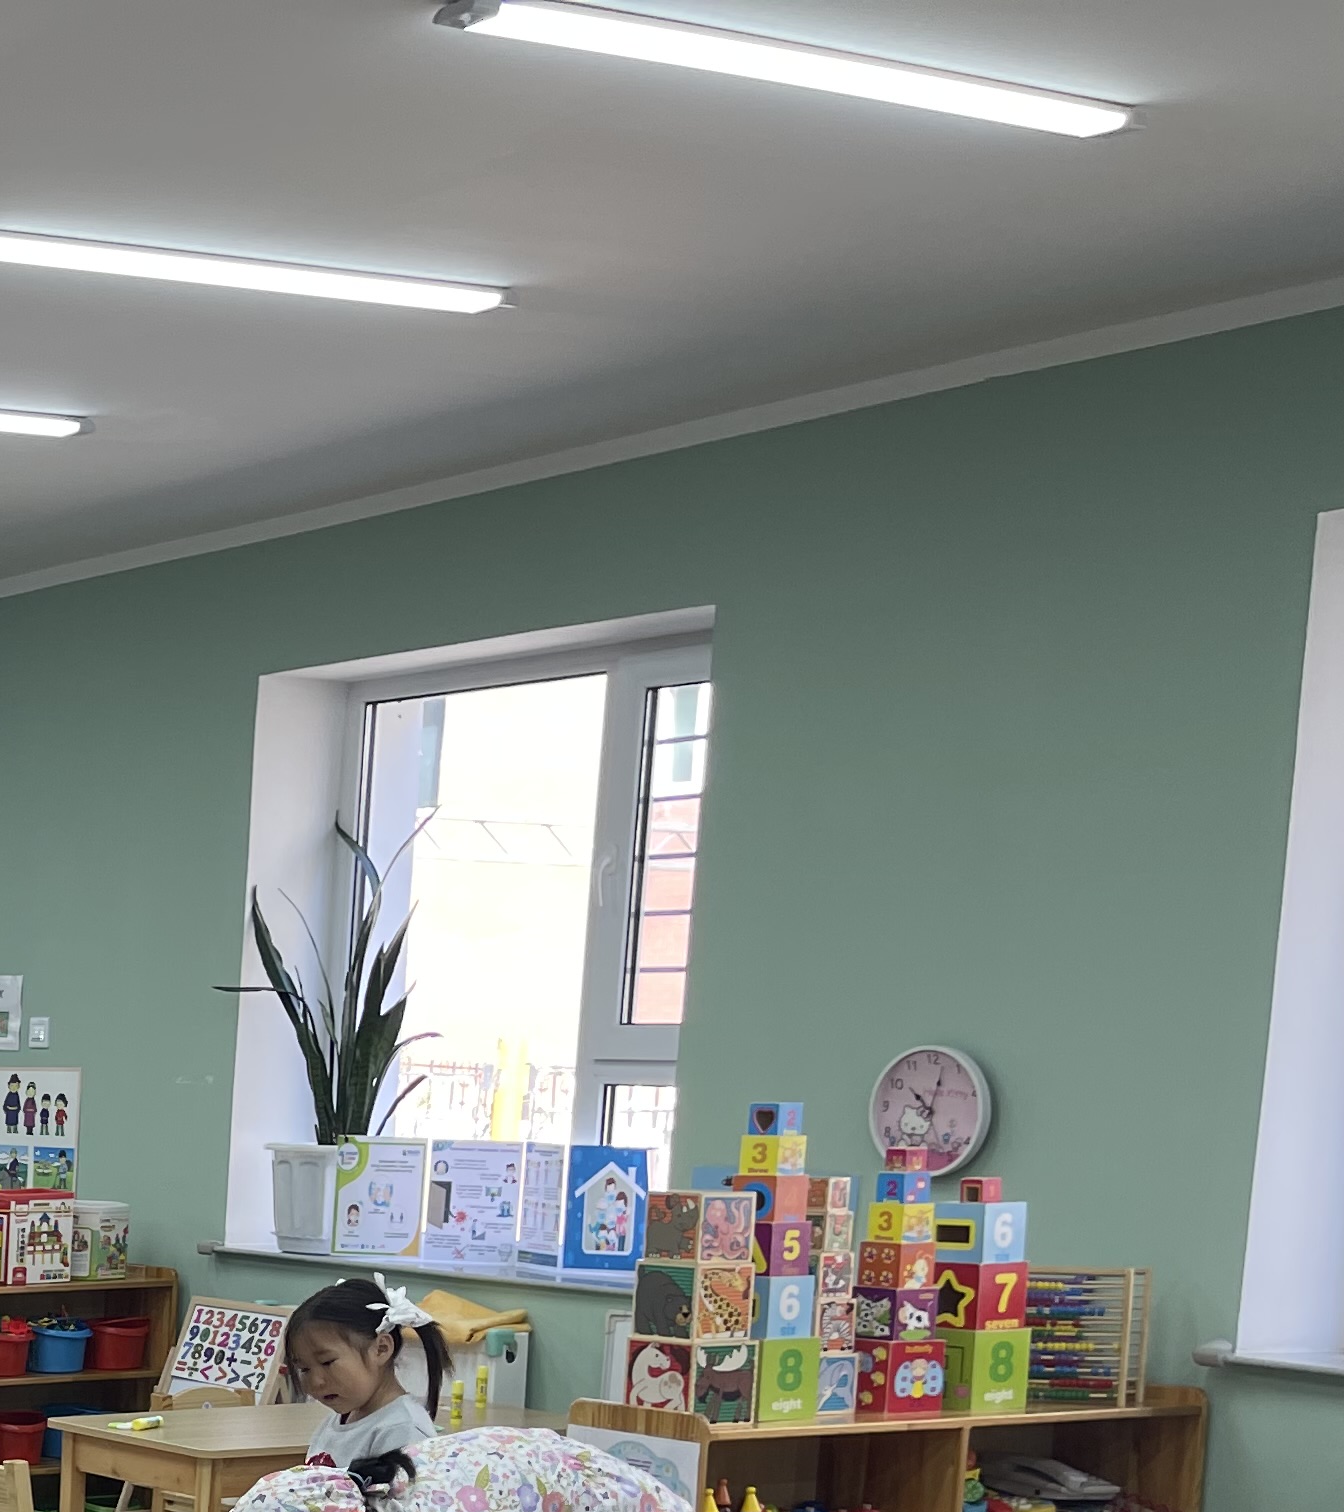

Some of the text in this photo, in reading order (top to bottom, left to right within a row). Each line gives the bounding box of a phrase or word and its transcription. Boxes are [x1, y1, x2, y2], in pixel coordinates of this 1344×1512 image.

[907, 1060, 917, 1071] 11
[927, 1054, 940, 1065] 12
[890, 1078, 904, 1090] 10
[882, 1100, 890, 1112] 9
[786, 1109, 797, 1127] 2
[884, 1126, 891, 1138] 8
[752, 1142, 768, 1164] 3
[886, 1180, 898, 1197] 2
[877, 1211, 893, 1232] 3
[994, 1212, 1014, 1248] 6
[783, 1229, 801, 1261] 5
[994, 1272, 1018, 1313] 7
[779, 1284, 801, 1321] 6
[984, 1318, 1020, 1330] seven
[777, 1348, 804, 1392] 8
[989, 1341, 1015, 1383] 8
[771, 1398, 803, 1414] eight
